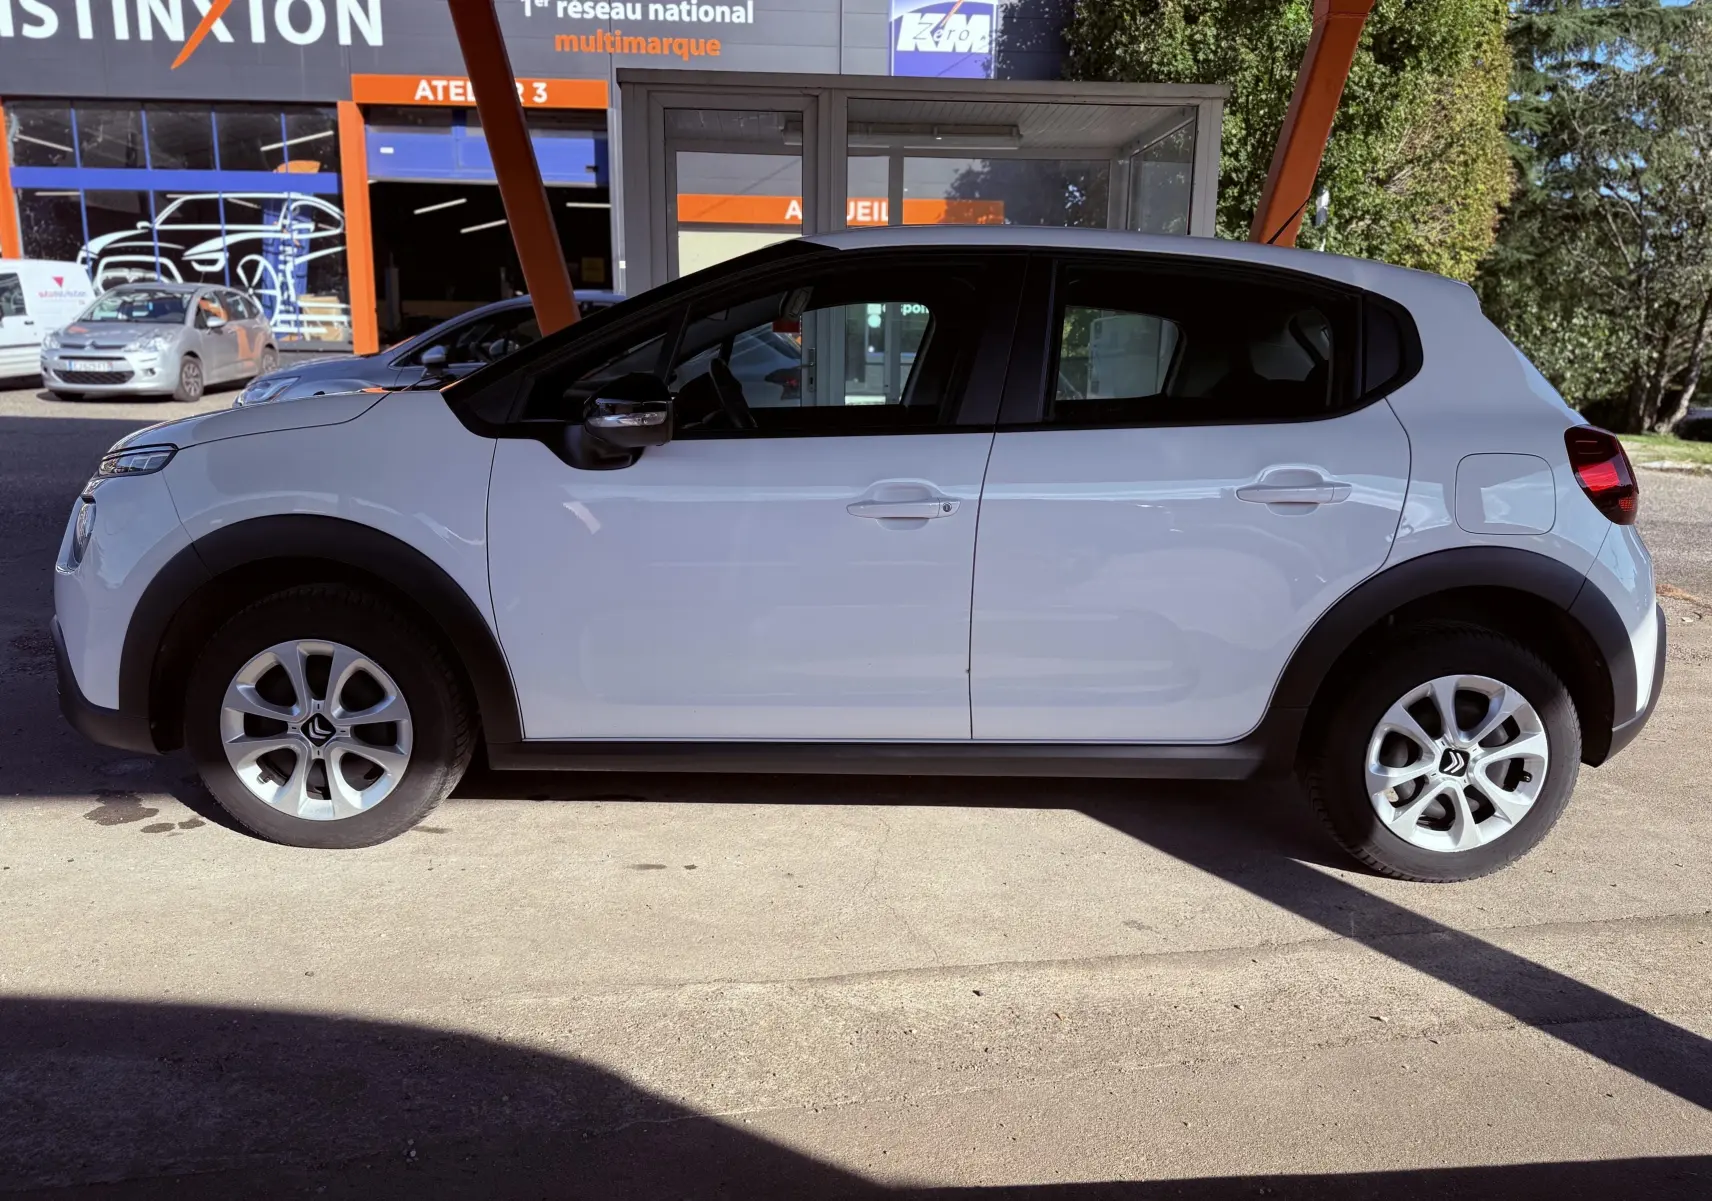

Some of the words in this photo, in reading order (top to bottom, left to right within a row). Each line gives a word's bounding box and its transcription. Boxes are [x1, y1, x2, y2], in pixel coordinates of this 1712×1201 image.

[649, 0, 754, 23] national
[554, 29, 721, 61] multimarque
[414, 79, 525, 103] ATELR
[532, 81, 548, 103] 3
[784, 199, 889, 222] AUEIL
